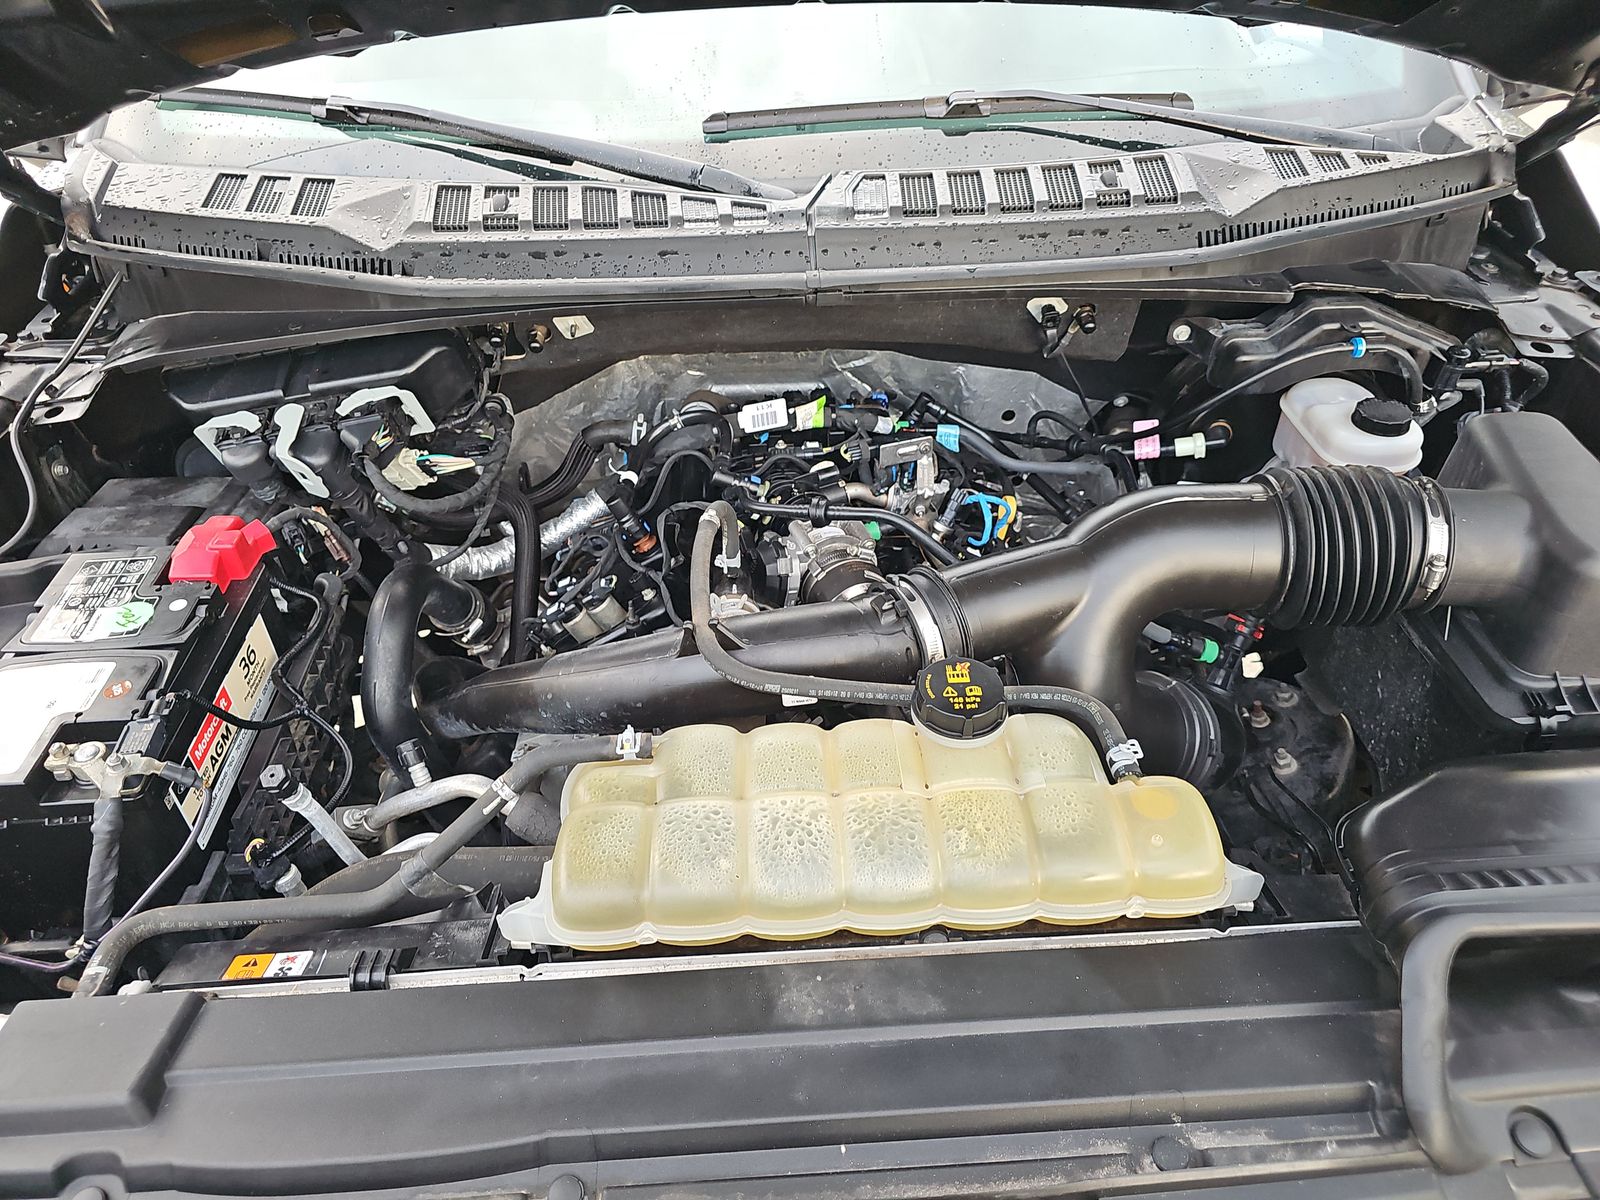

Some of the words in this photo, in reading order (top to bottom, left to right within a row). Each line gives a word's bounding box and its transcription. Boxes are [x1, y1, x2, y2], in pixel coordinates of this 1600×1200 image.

[239, 643, 257, 680] 36
[247, 660, 260, 687] MONTH
[194, 697, 229, 761] Motorcft
[209, 724, 233, 772] AGM
